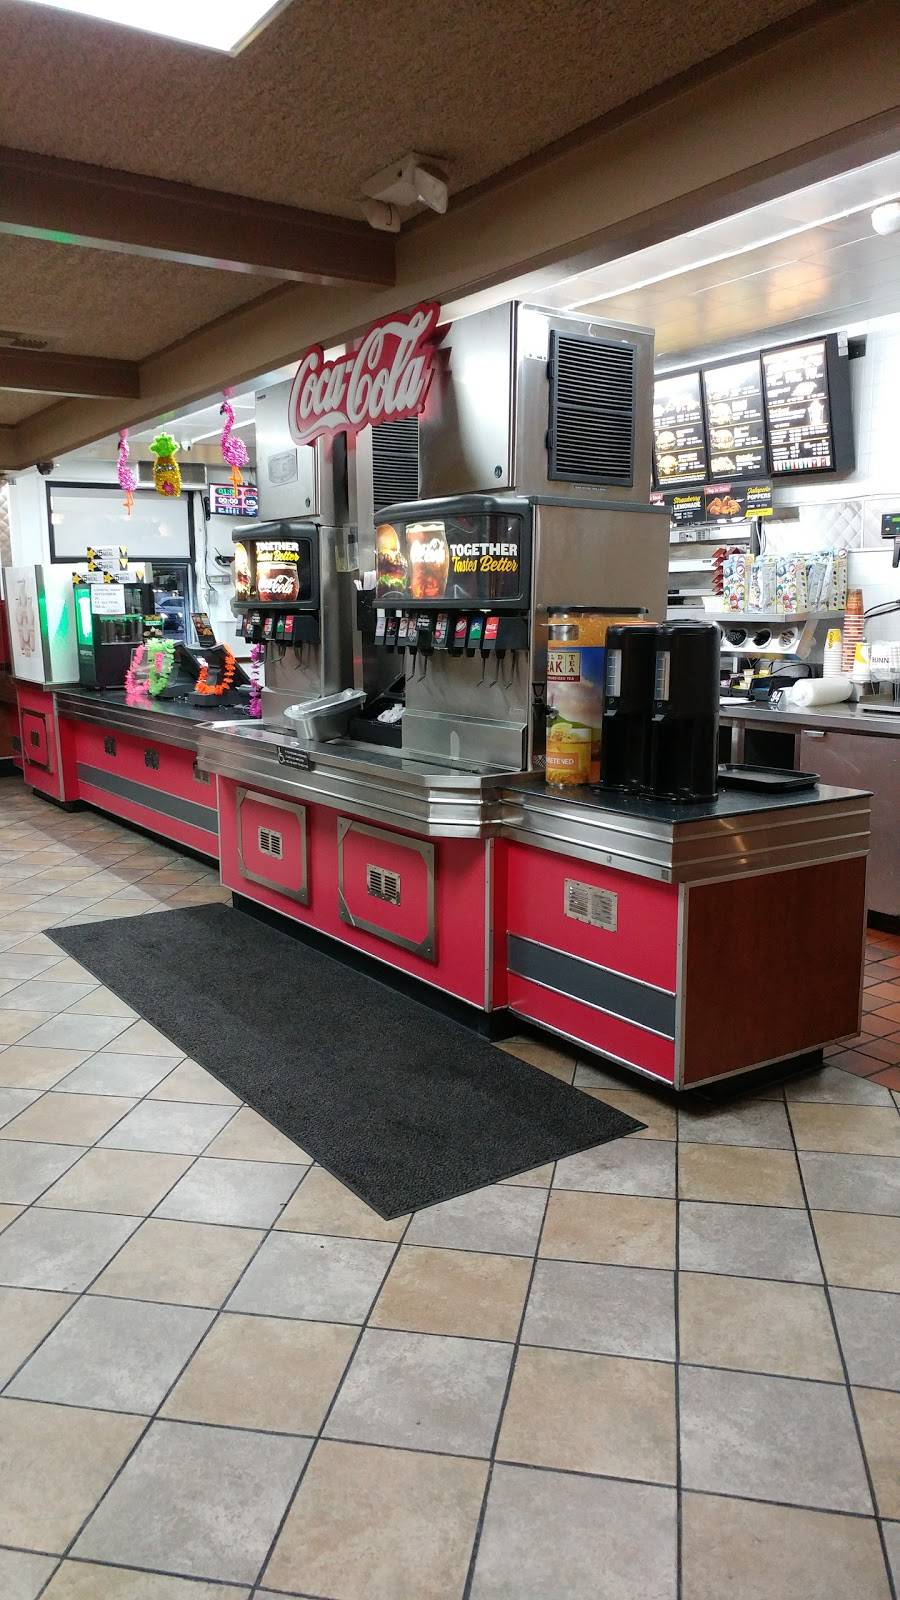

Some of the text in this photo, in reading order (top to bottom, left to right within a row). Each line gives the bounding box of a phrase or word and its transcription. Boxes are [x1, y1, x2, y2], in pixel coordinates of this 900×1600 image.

[289, 310, 433, 438] Coca-Cola
[747, 493, 771, 501] POPPERS
[673, 501, 701, 510] LEMONADE
[256, 541, 299, 552] TOGETHER
[450, 543, 518, 556] TOGETHER
[451, 554, 519, 573] Tastes Better
[568, 654, 576, 673] TEA
